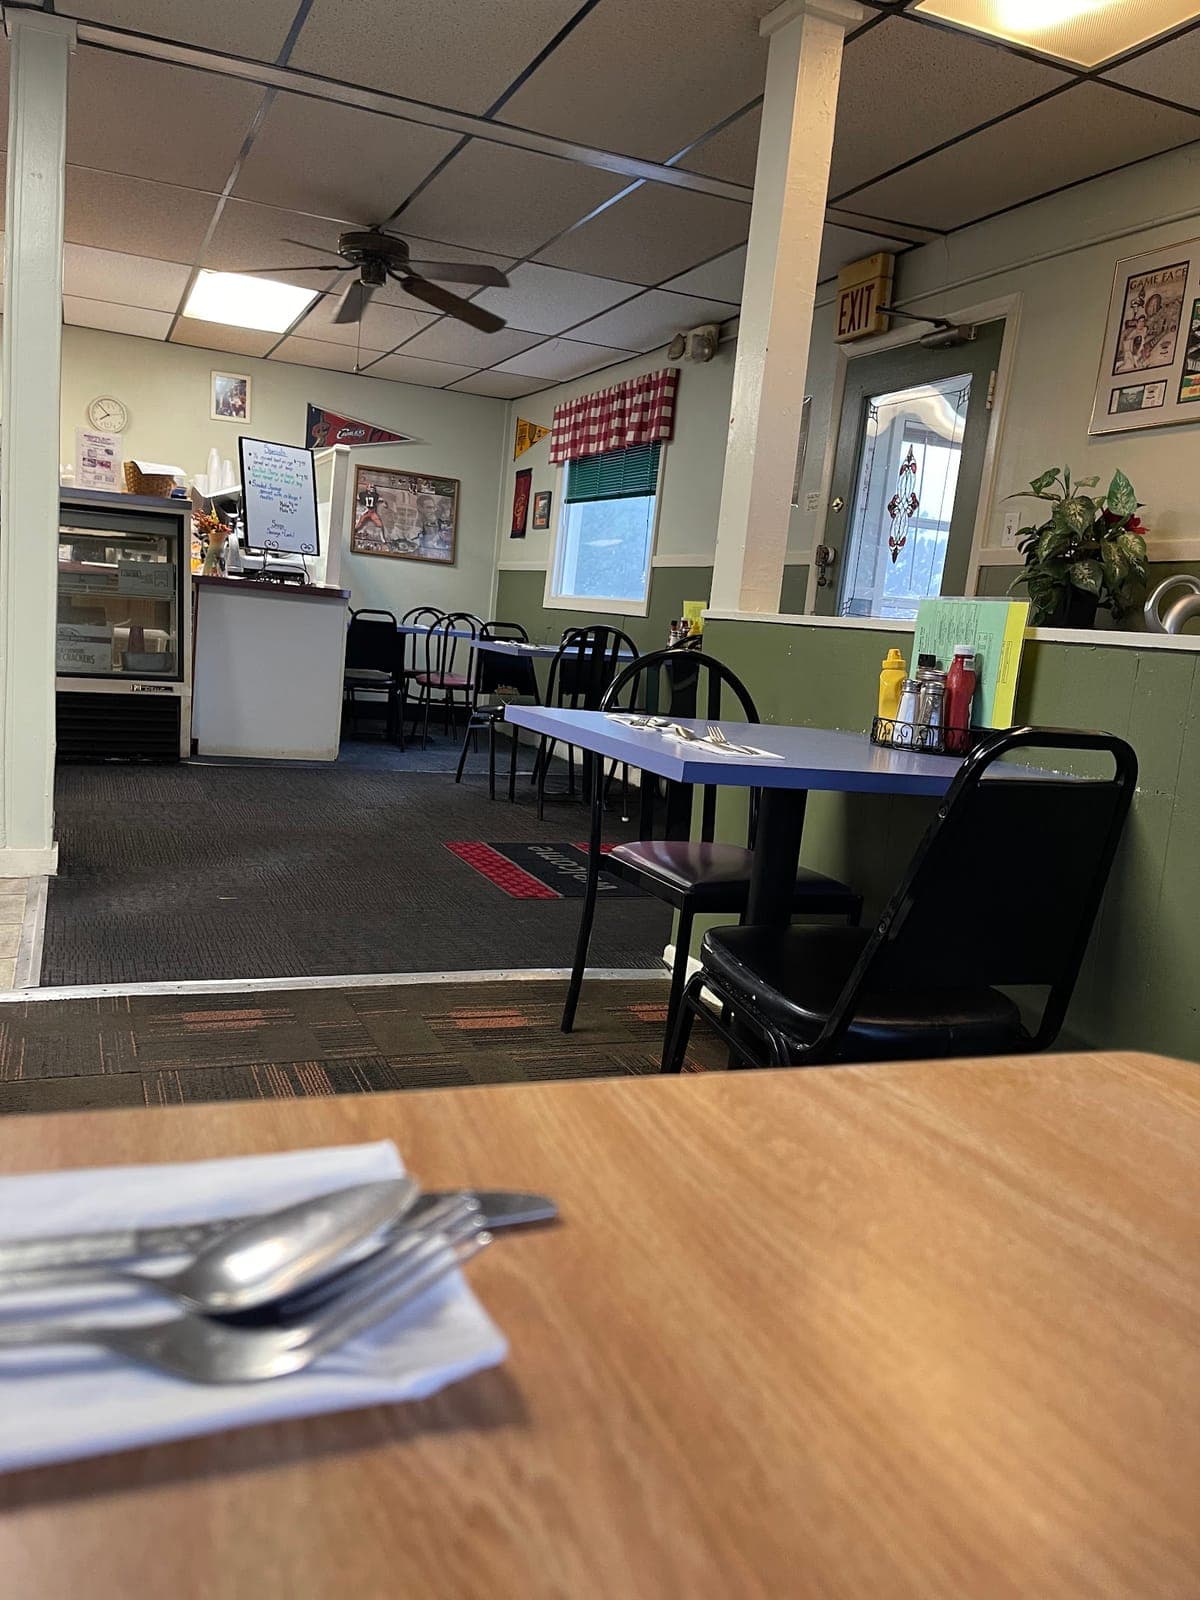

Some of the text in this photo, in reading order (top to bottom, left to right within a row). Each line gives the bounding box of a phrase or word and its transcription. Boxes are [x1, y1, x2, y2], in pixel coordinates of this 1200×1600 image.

[1130, 267, 1188, 290] GAME FACE
[838, 283, 875, 336] EXIT
[365, 497, 374, 508] 17
